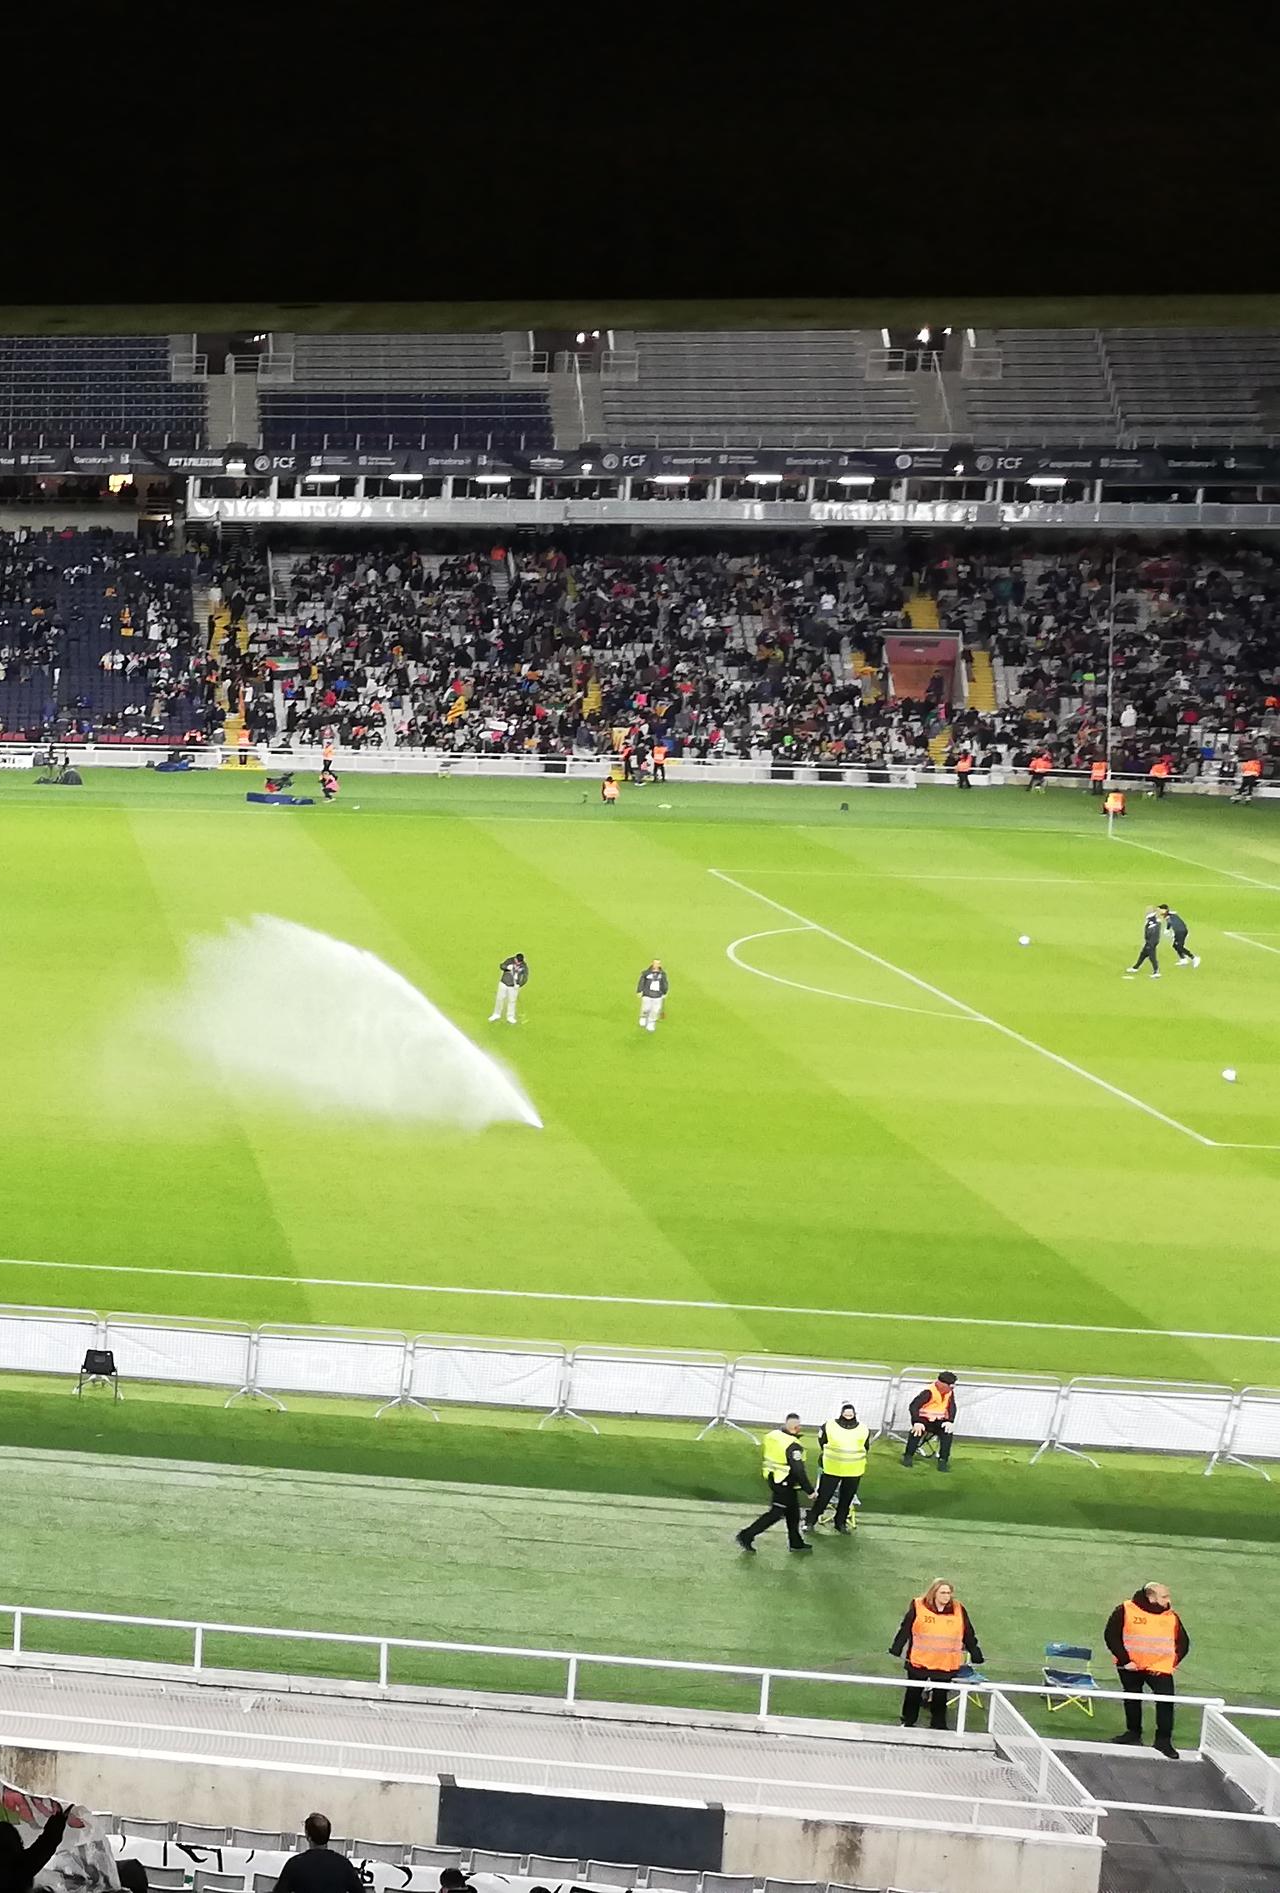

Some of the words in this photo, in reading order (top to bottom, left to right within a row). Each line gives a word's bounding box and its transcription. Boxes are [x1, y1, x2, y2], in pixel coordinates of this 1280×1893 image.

[273, 456, 296, 468] FCF
[622, 455, 647, 467] FCF
[997, 457, 1023, 469] FCF
